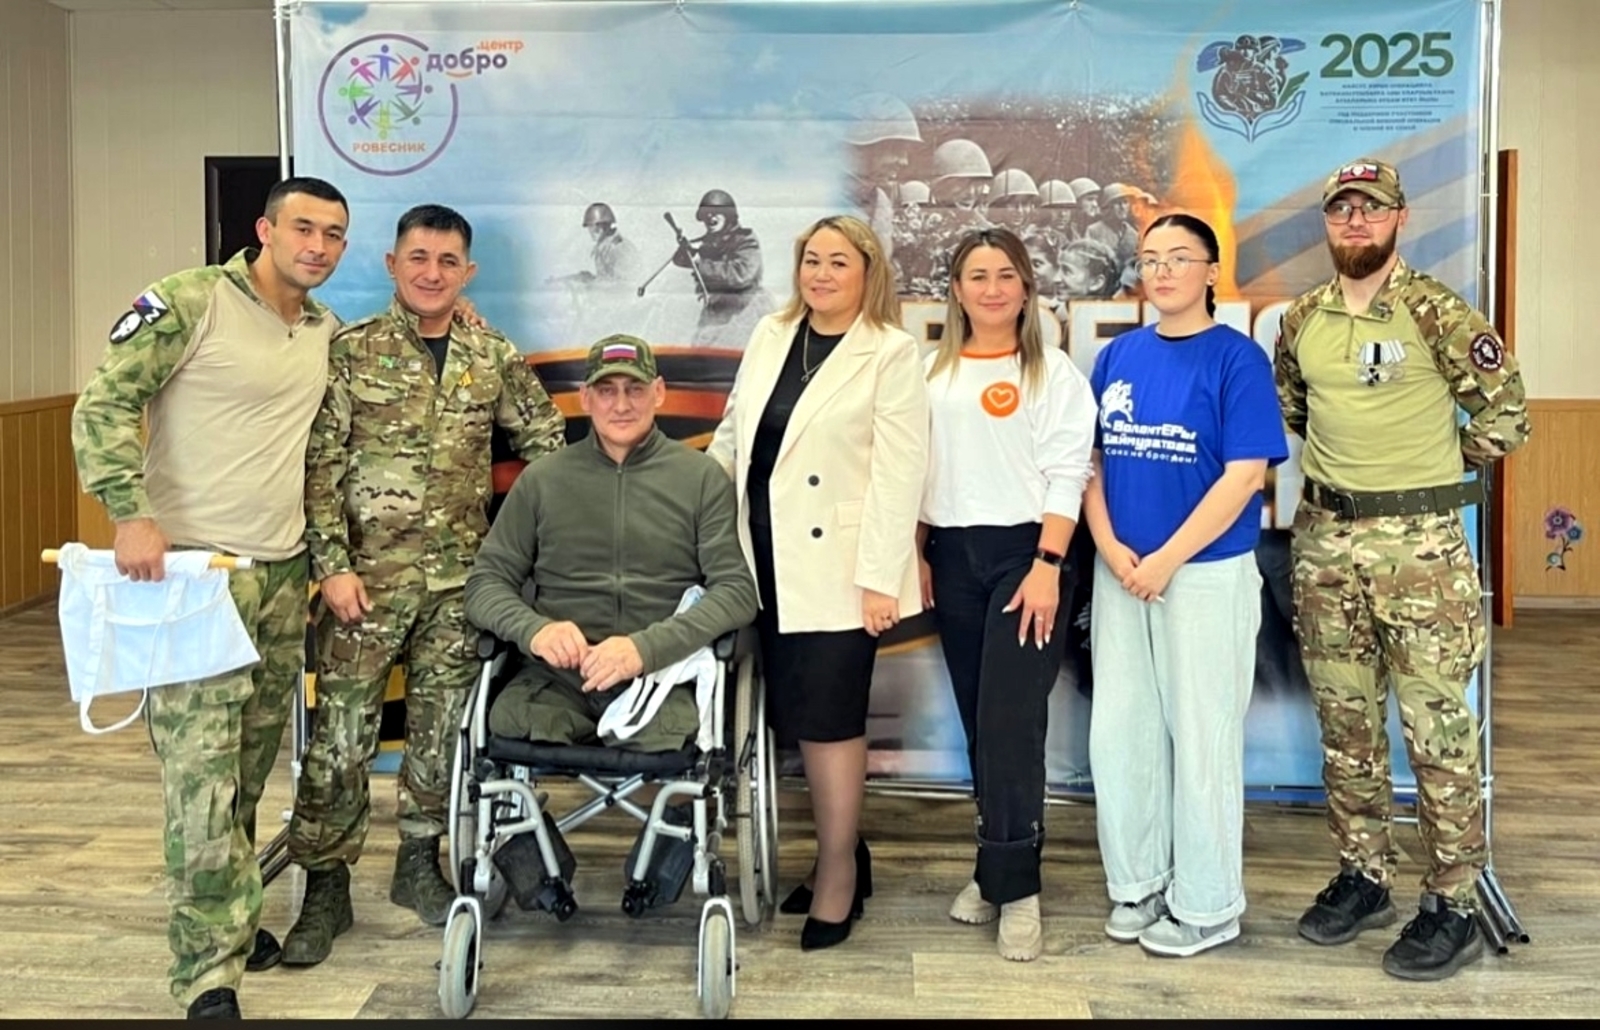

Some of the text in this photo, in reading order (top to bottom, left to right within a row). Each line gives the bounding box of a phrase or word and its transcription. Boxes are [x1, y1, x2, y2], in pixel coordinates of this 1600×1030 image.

[426, 47, 507, 74] добро
[1319, 31, 1454, 78] 2025
[352, 142, 427, 153] РОВЕСНИК
